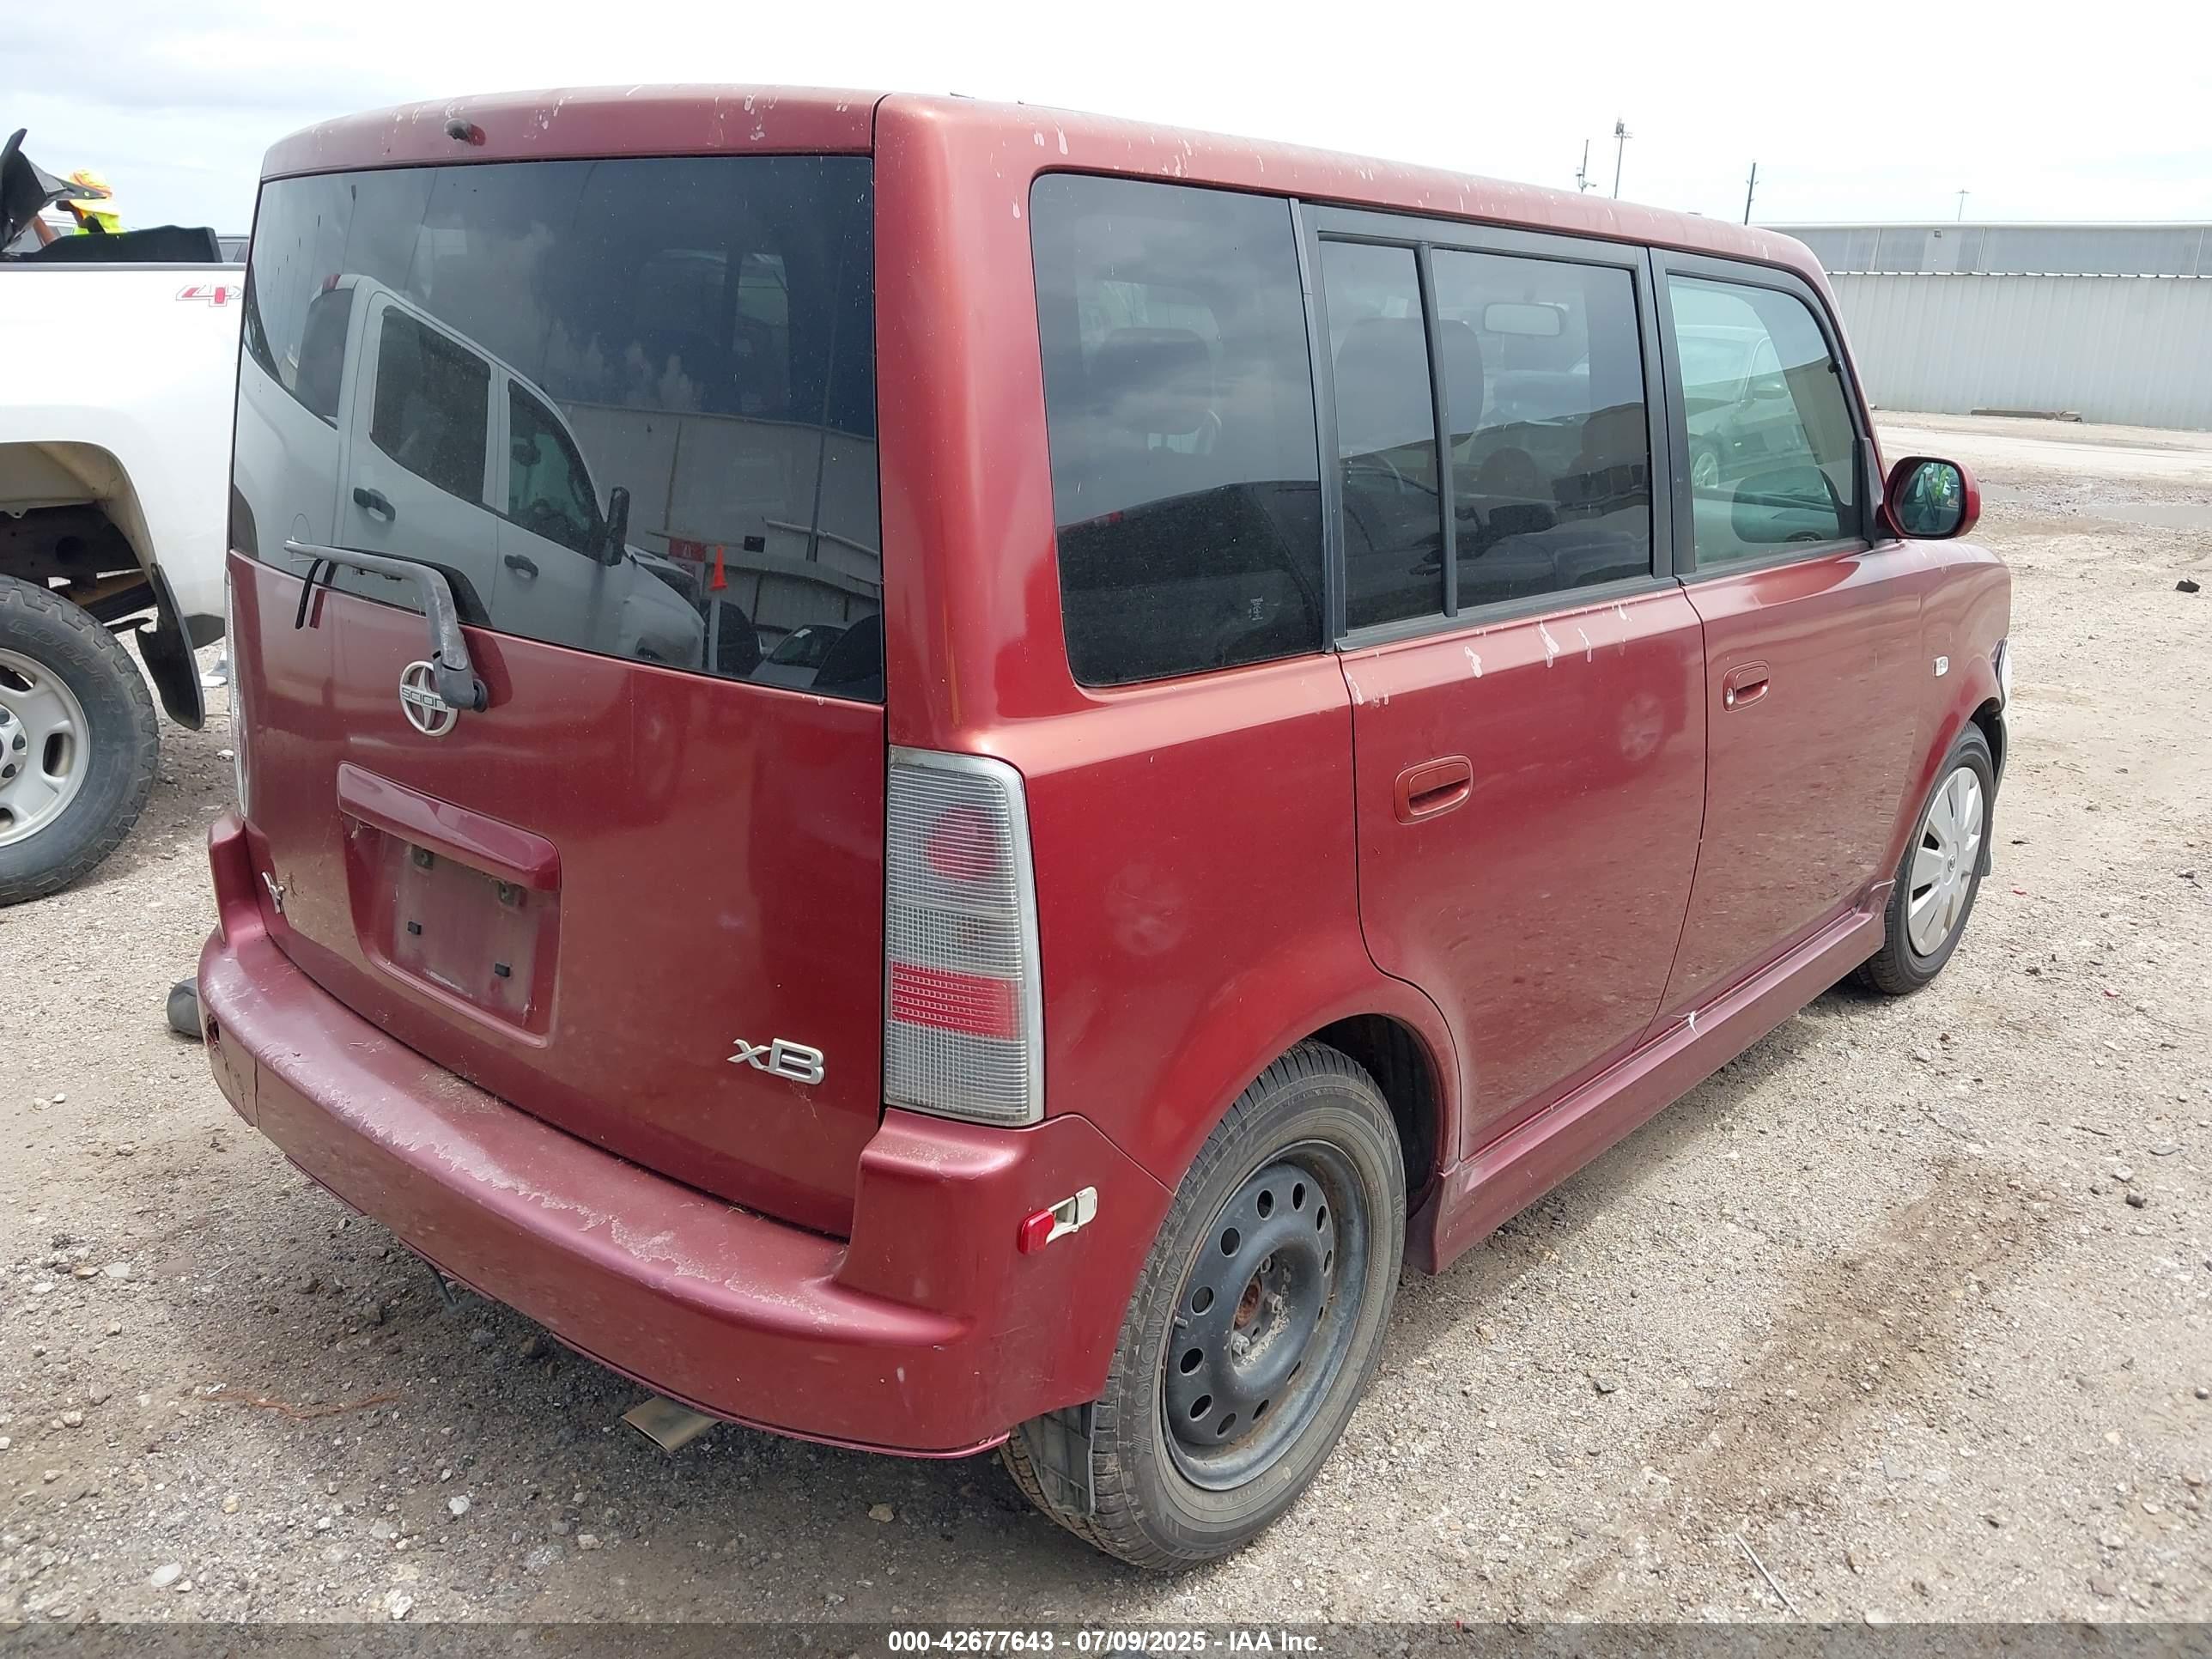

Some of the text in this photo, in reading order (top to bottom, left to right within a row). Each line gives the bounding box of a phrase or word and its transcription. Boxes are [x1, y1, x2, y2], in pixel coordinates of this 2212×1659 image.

[7, 617, 122, 714] COOPER
[401, 686, 447, 711] SCION
[726, 1037, 825, 1085] xB
[1133, 1244, 1191, 1419] YOKOHAMA
